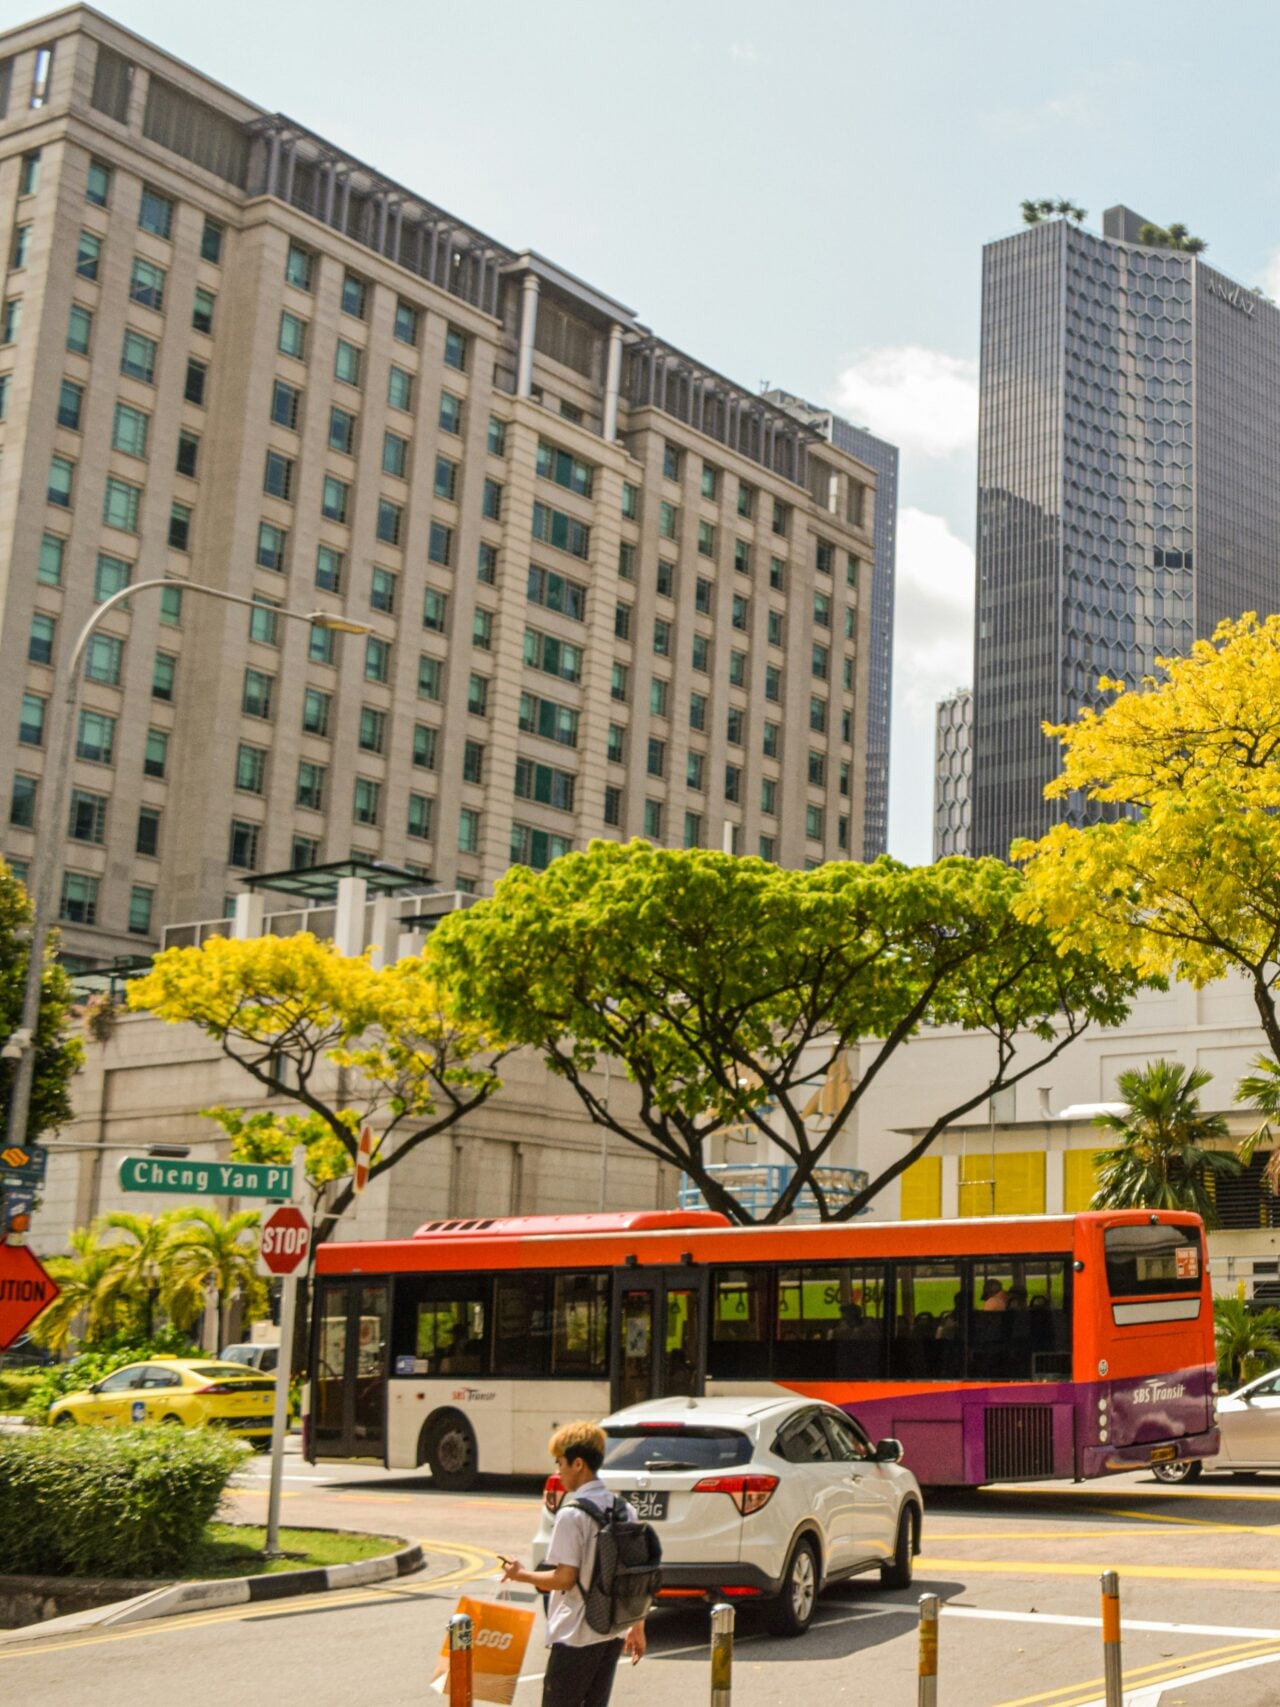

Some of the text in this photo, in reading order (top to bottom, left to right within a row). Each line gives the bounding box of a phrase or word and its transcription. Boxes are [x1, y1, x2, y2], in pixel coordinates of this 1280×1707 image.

[134, 1161, 288, 1191] Cheng Yan Pl
[263, 1226, 309, 1255] STOP
[1132, 1380, 1187, 1404] SBS Transit
[630, 1491, 658, 1504] SJV
